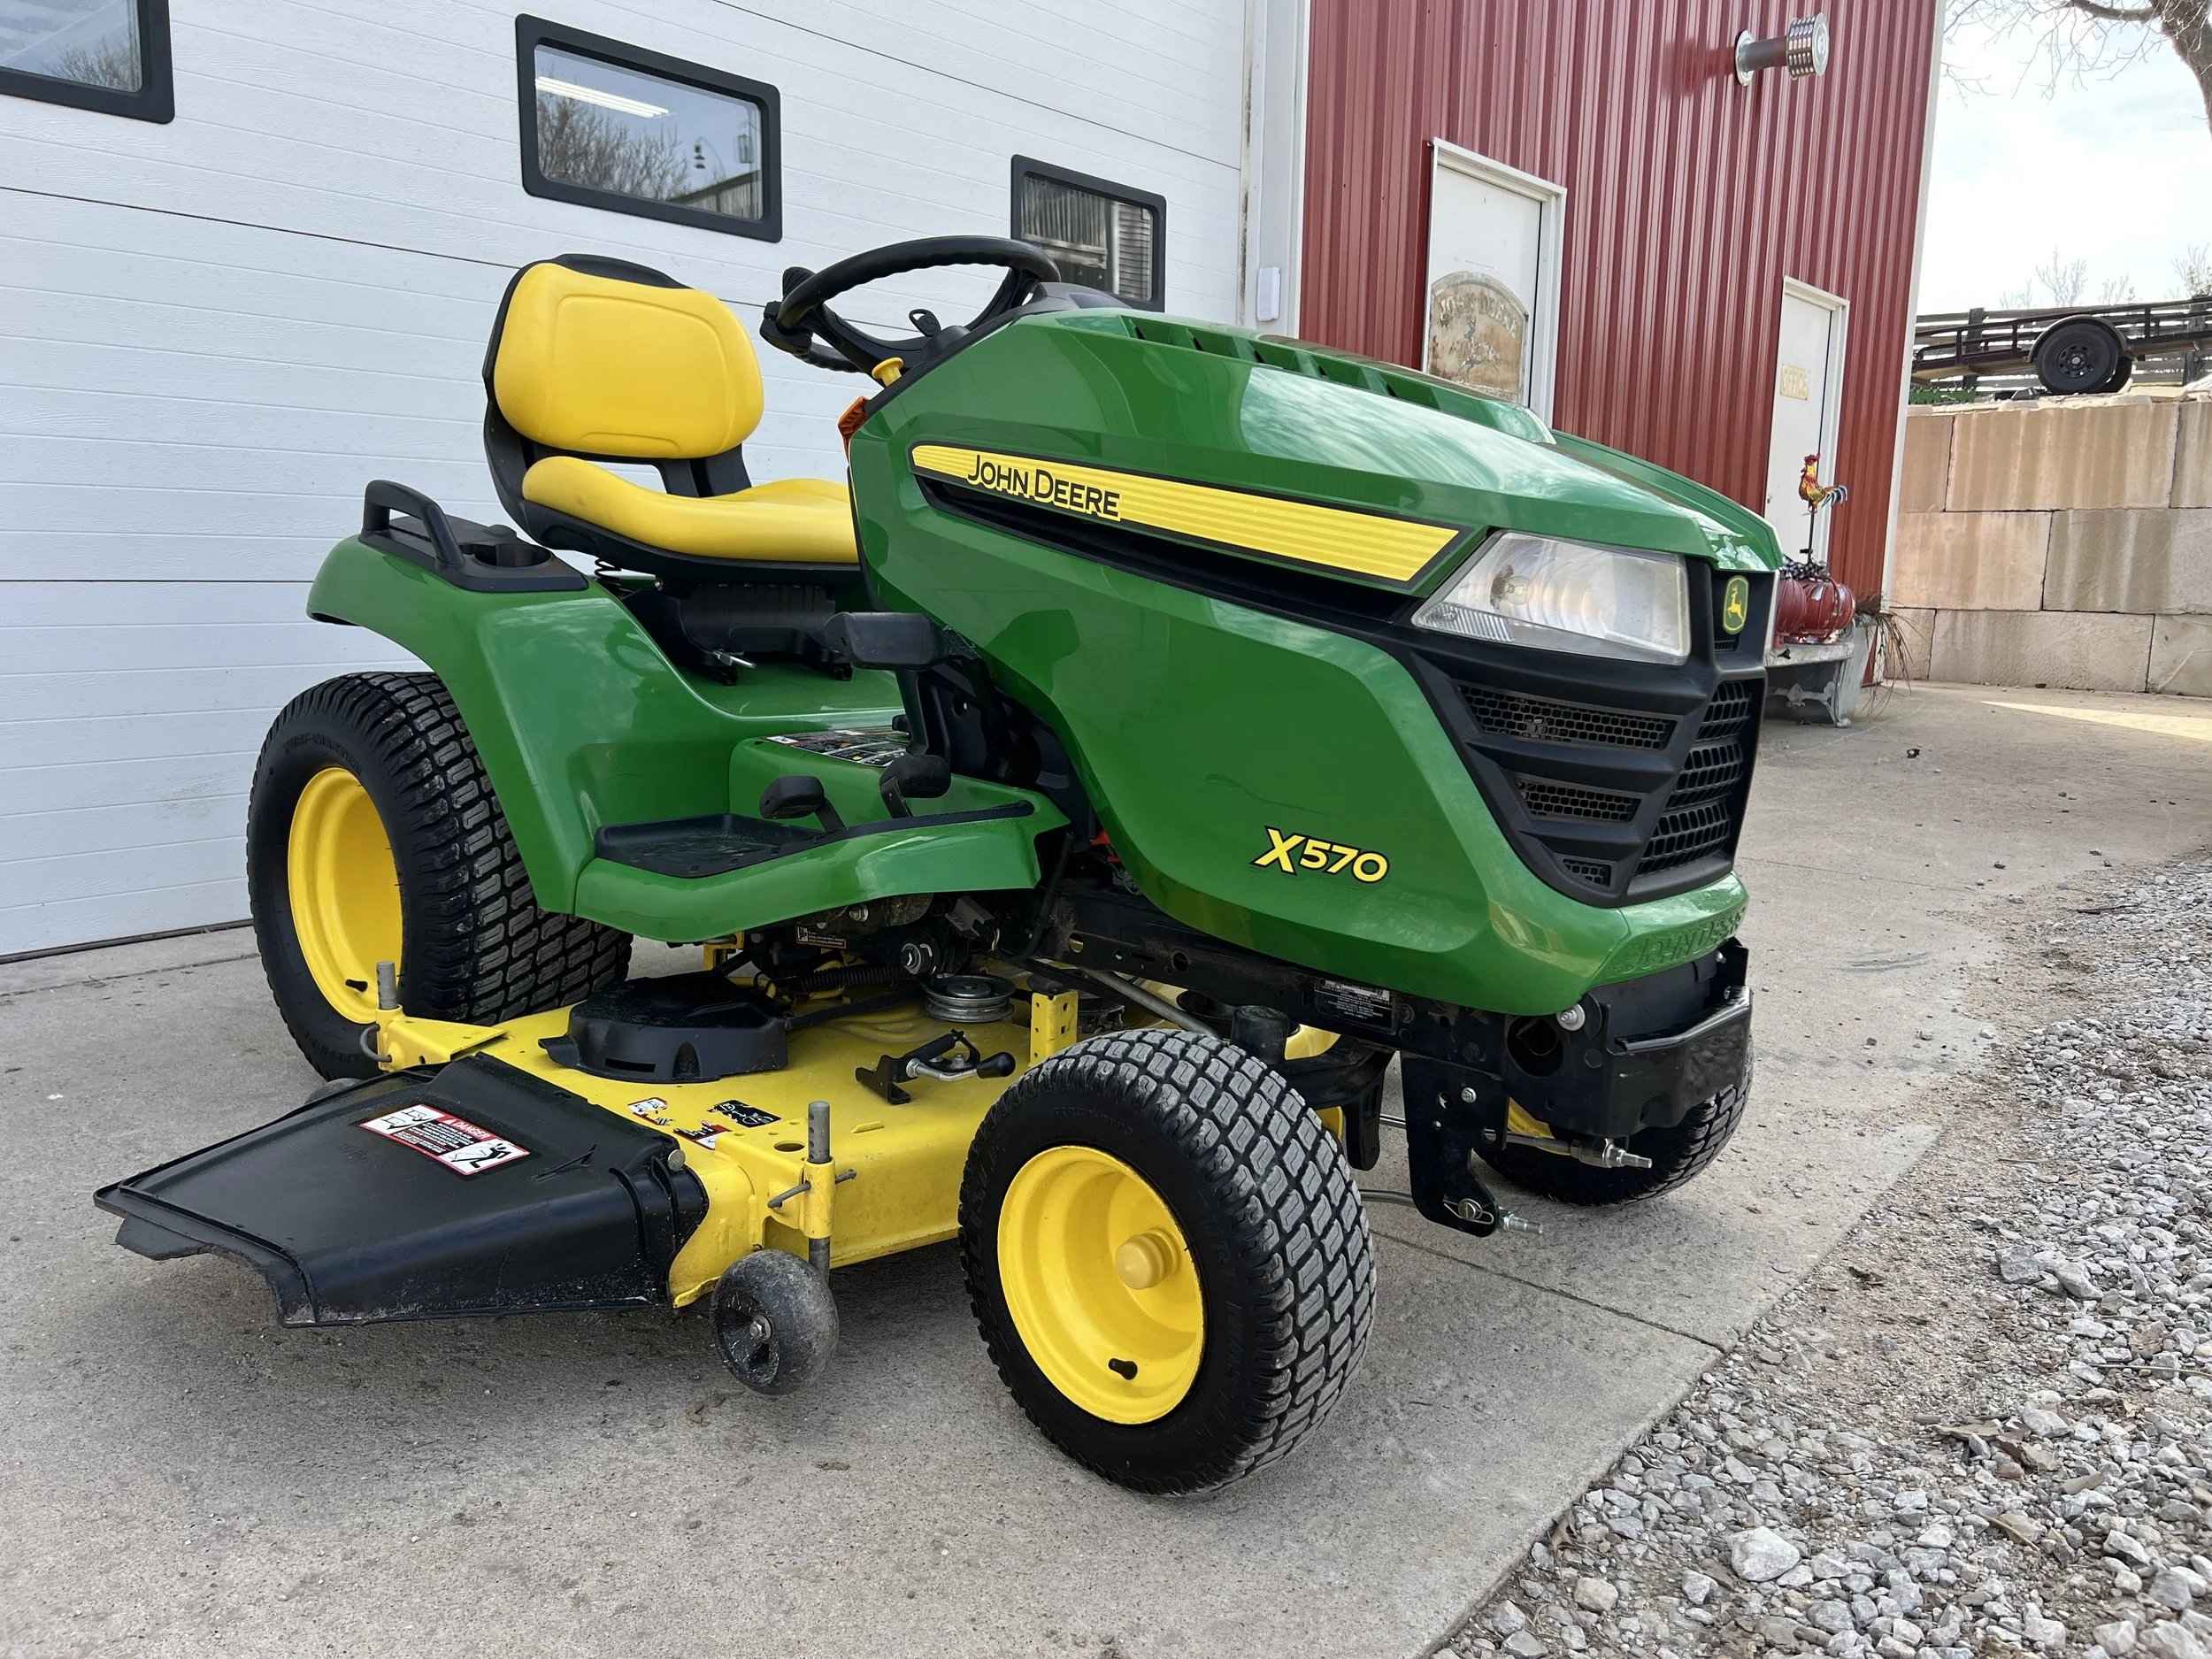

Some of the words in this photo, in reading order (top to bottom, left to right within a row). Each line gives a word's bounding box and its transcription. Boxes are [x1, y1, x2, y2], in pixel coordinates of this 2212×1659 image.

[1782, 369, 1809, 396] OFFICE
[967, 454, 1029, 496] JOHN
[1034, 468, 1120, 519] DEERE
[1251, 826, 1389, 883] X570
[1621, 930, 1694, 974] JOHN
[453, 1121, 491, 1139] DANGER
